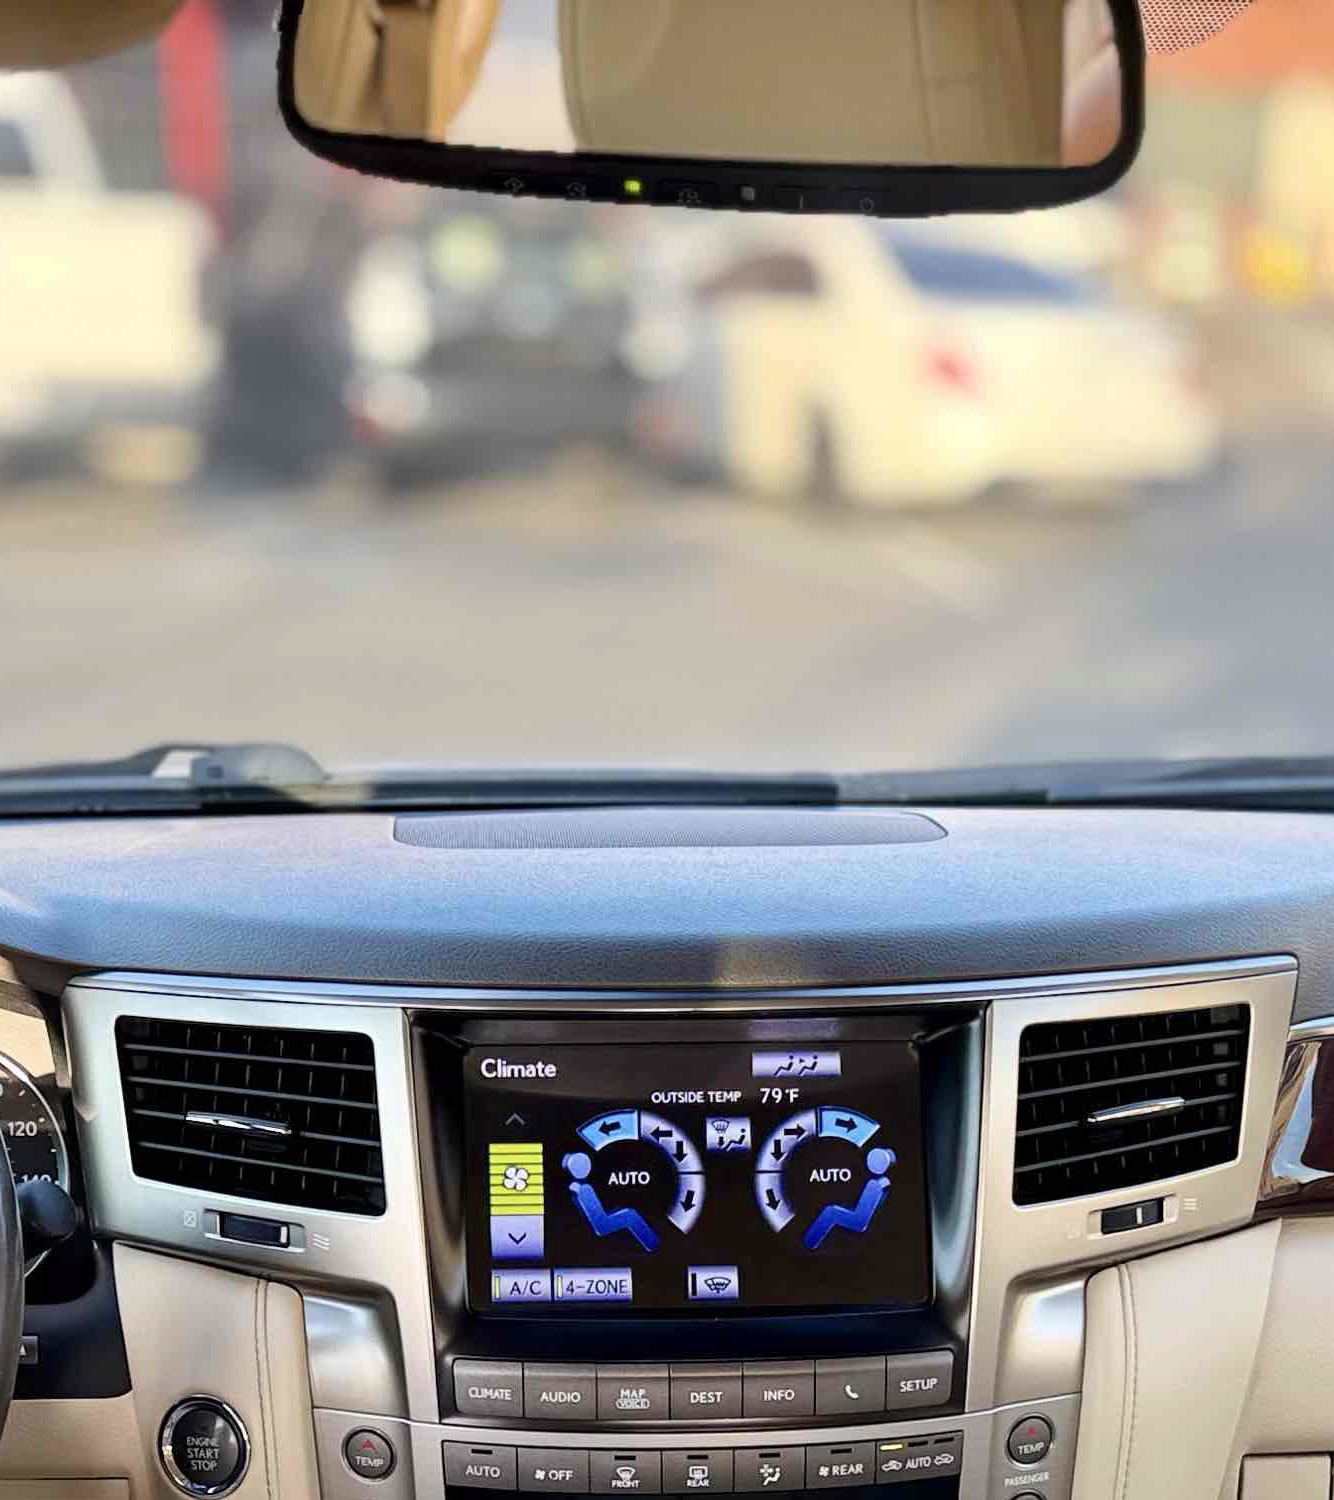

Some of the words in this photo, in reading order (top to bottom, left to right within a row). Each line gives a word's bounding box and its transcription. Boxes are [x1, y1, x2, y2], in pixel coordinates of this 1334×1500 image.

[480, 1057, 557, 1079] Climate
[650, 1090, 705, 1104] OUTSIDE
[707, 1090, 742, 1104] TEMP
[7, 1120, 38, 1137] 120
[607, 1170, 651, 1186] AUTO
[808, 1167, 852, 1183] AUTO
[509, 1280, 542, 1296] A/C
[566, 1279, 628, 1295] 4-ZONE
[899, 1377, 938, 1393] SETUP
[467, 1386, 512, 1400] CLIMATE
[540, 1391, 581, 1403] AUDIO
[619, 1388, 646, 1399] MAP
[690, 1391, 723, 1404] DEST
[763, 1388, 795, 1401] INFO
[186, 1436, 220, 1448] ENGINE
[186, 1447, 220, 1460] START
[190, 1460, 218, 1472] STOP
[904, 1455, 933, 1470] AUTO
[465, 1464, 501, 1479] AUTO
[548, 1470, 574, 1482] OFF
[832, 1464, 865, 1477] REAR
[686, 1479, 710, 1488] REAR
